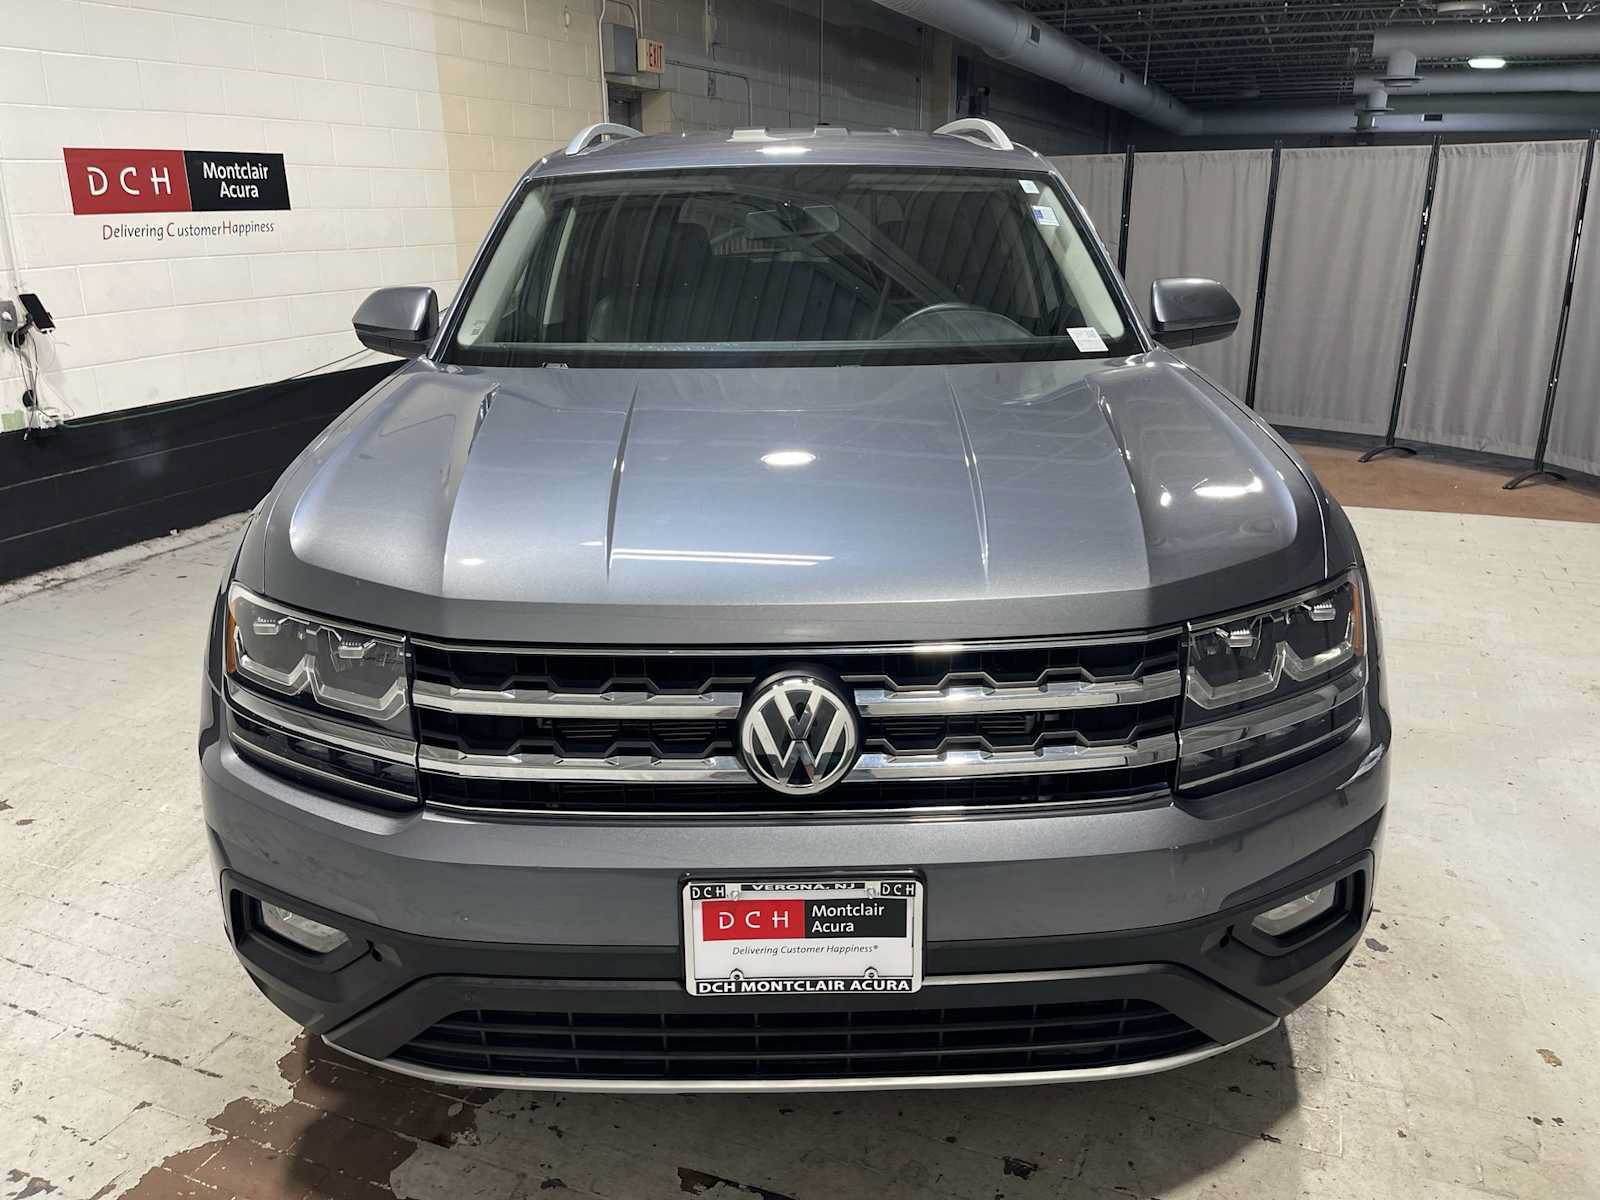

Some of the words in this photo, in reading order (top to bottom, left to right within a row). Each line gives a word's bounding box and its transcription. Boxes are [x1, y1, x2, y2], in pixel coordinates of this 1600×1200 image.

[648, 42, 663, 69] EXIT
[203, 161, 269, 181] Montclair
[220, 182, 260, 198] Acura
[102, 224, 164, 241] Delivering
[692, 886, 725, 899] DCH
[882, 883, 915, 896] DCH
[811, 902, 885, 918] Montclair
[811, 920, 855, 933] Acura
[732, 945, 778, 957] Delivering
[780, 945, 825, 955] Customer
[699, 981, 736, 994] DCH
[740, 979, 845, 993] MONTCLAIR
[849, 978, 910, 992] ACURA
